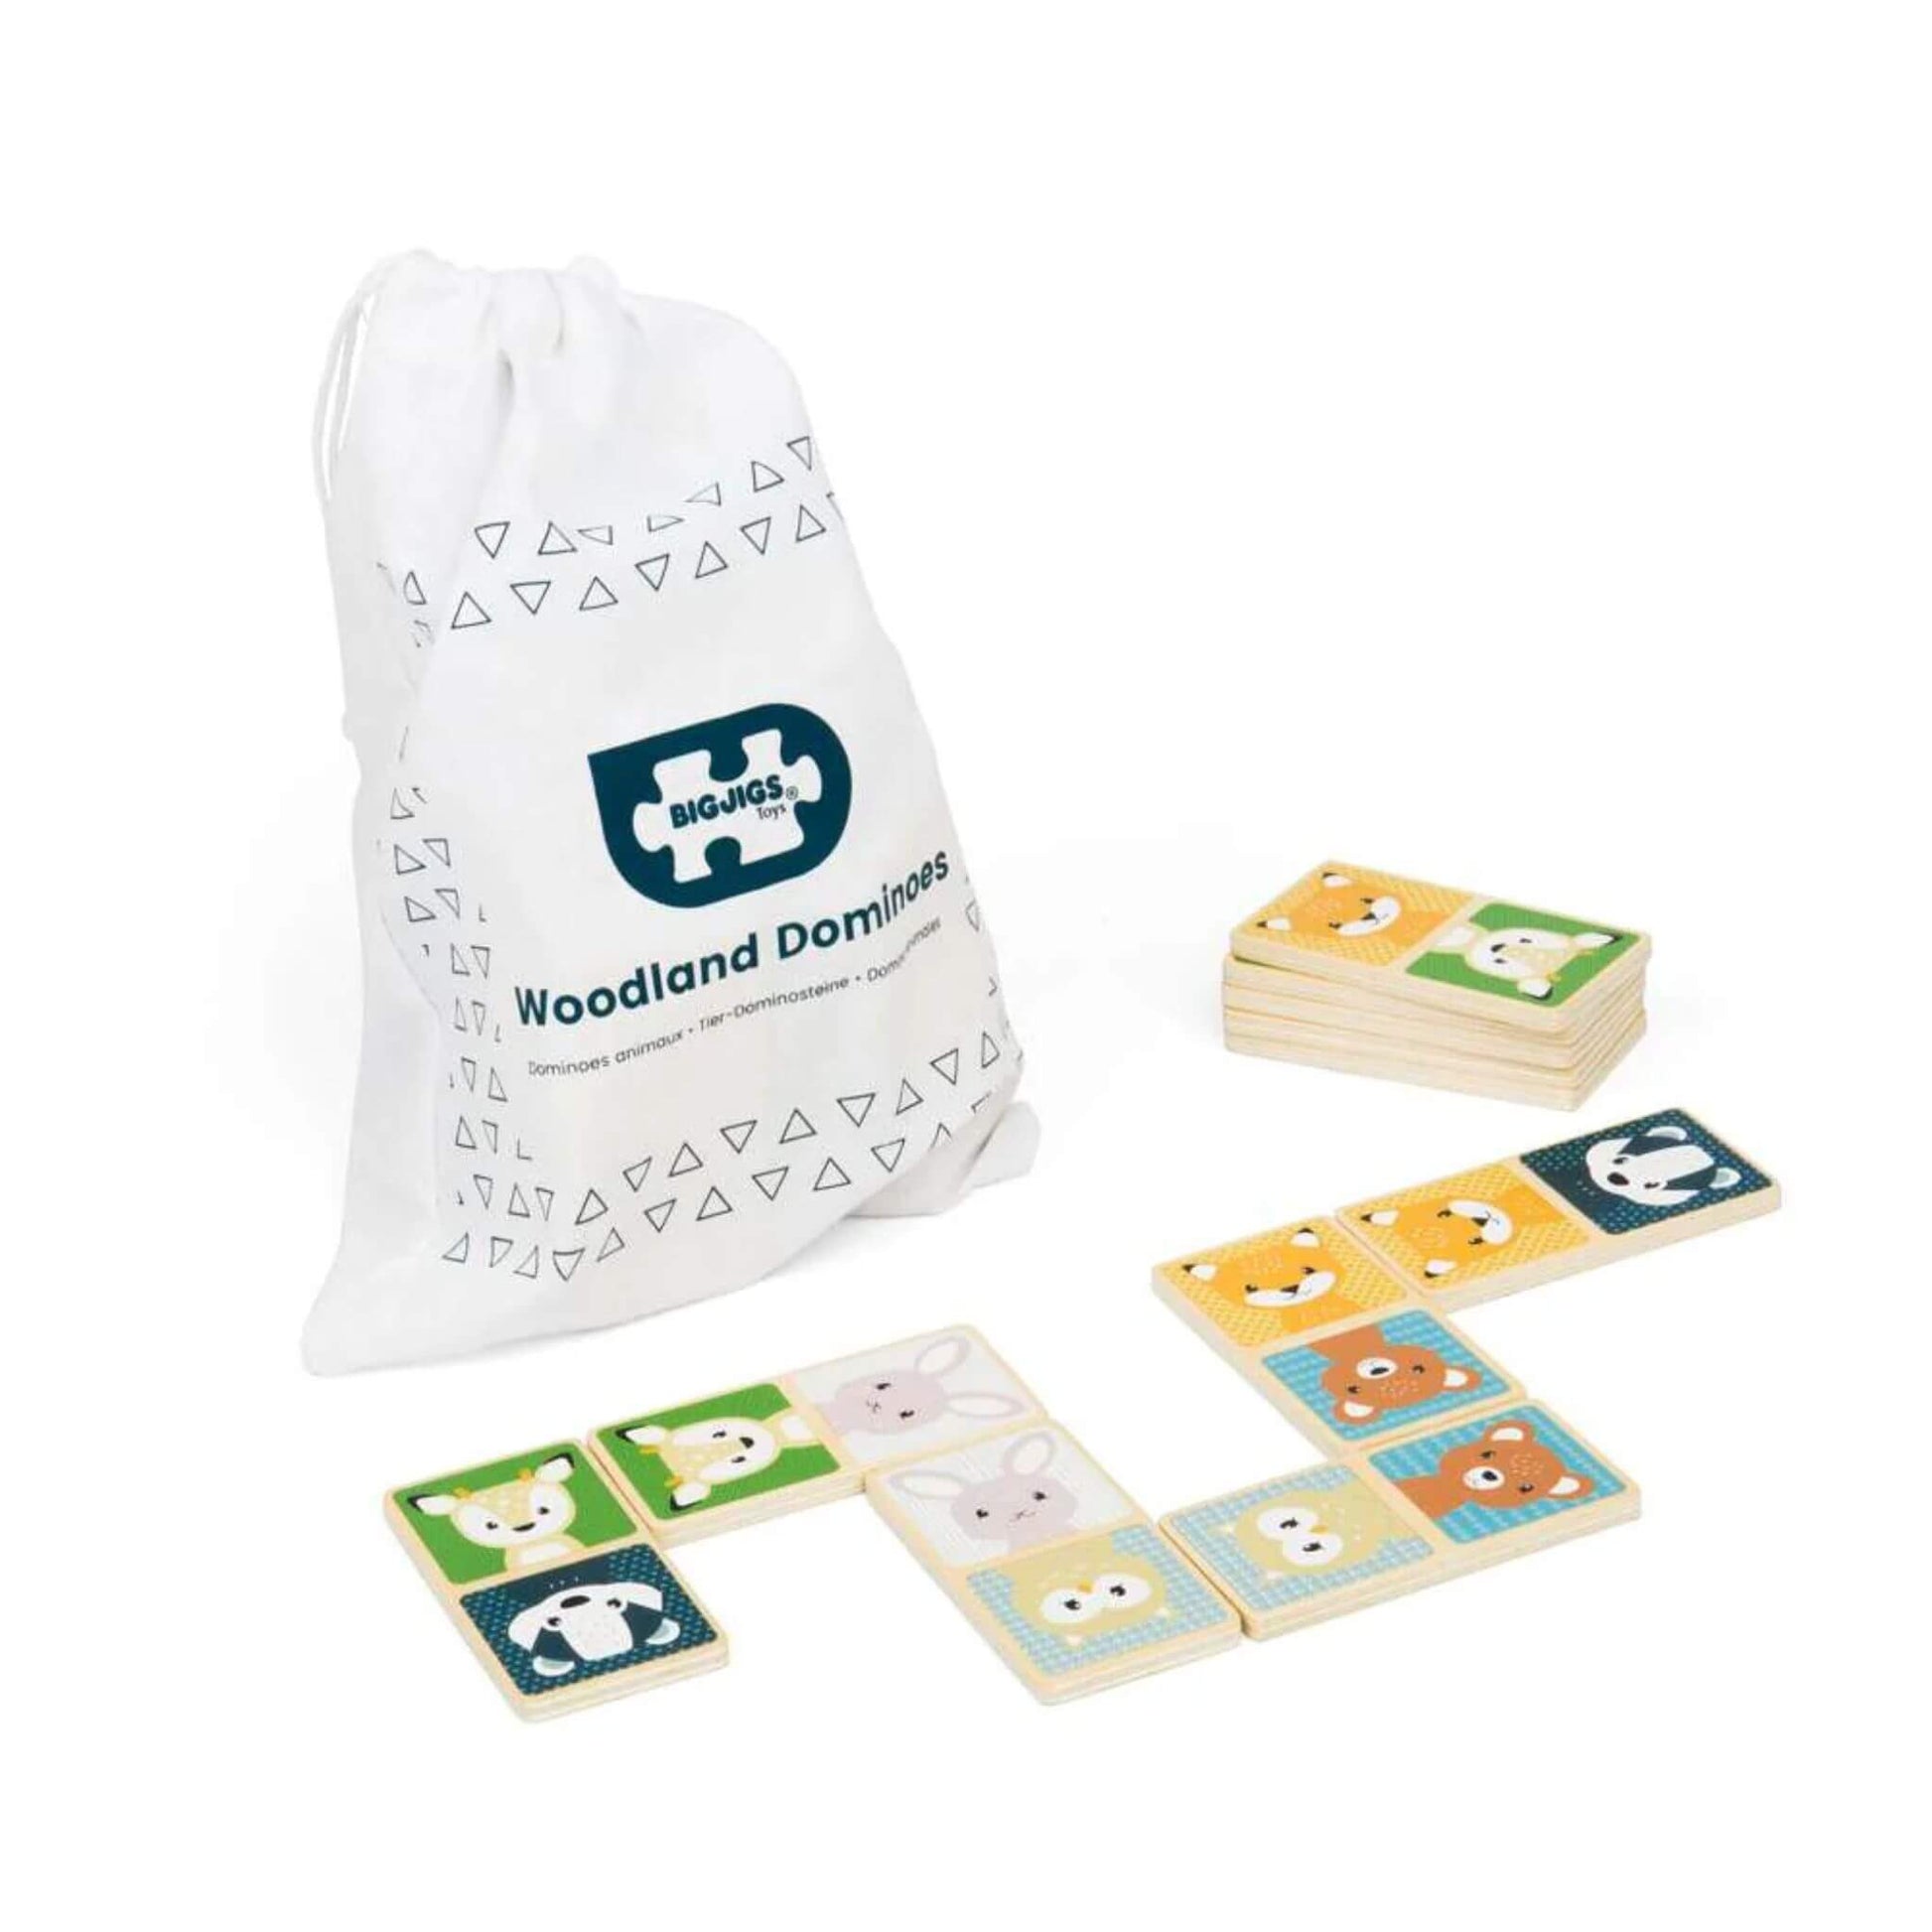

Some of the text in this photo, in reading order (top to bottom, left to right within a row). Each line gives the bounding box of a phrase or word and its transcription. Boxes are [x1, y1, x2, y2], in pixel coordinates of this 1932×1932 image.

[757, 803, 787, 821] Toys
[514, 850, 949, 1027] Woodland Dominoes
[528, 1054, 611, 1076] Dominoes
[615, 1029, 684, 1064] animaux
[699, 978, 850, 1034] Tier-Dominosteine
